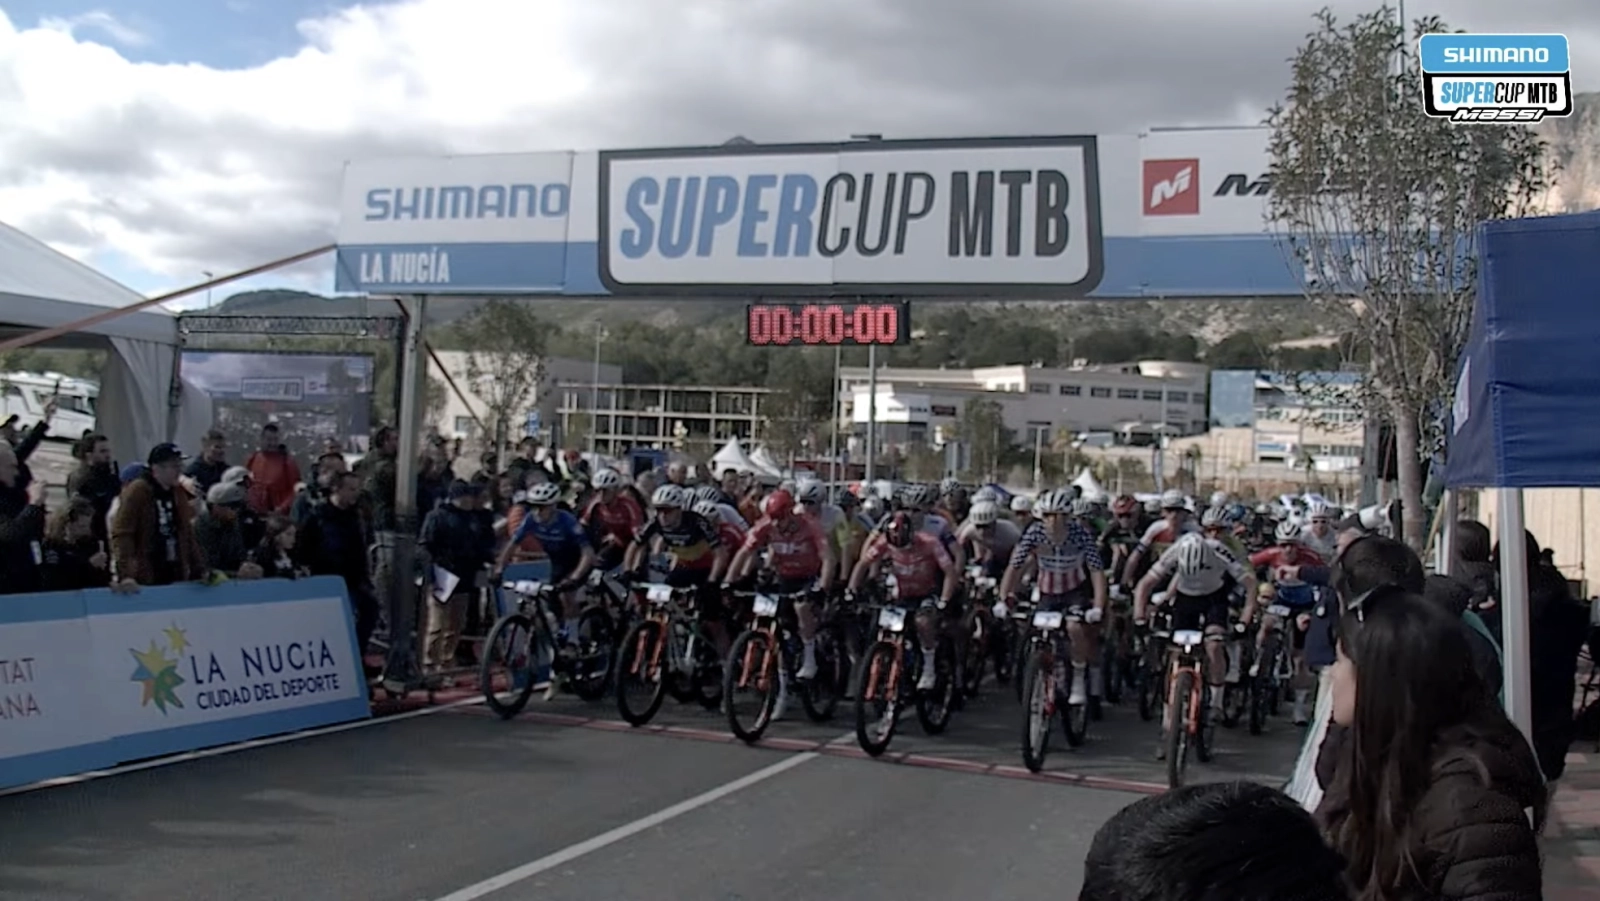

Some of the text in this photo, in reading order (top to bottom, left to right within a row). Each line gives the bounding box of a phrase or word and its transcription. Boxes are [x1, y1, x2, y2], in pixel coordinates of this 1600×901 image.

[365, 183, 570, 221] SHIMANO
[620, 169, 1070, 259] SUPERCUP MTB
[360, 247, 450, 283] LA NUCÍA
[749, 304, 899, 345] 00:00:00
[190, 652, 226, 685] LA
[197, 673, 340, 710] CIUDAD DEL DEPORTE
